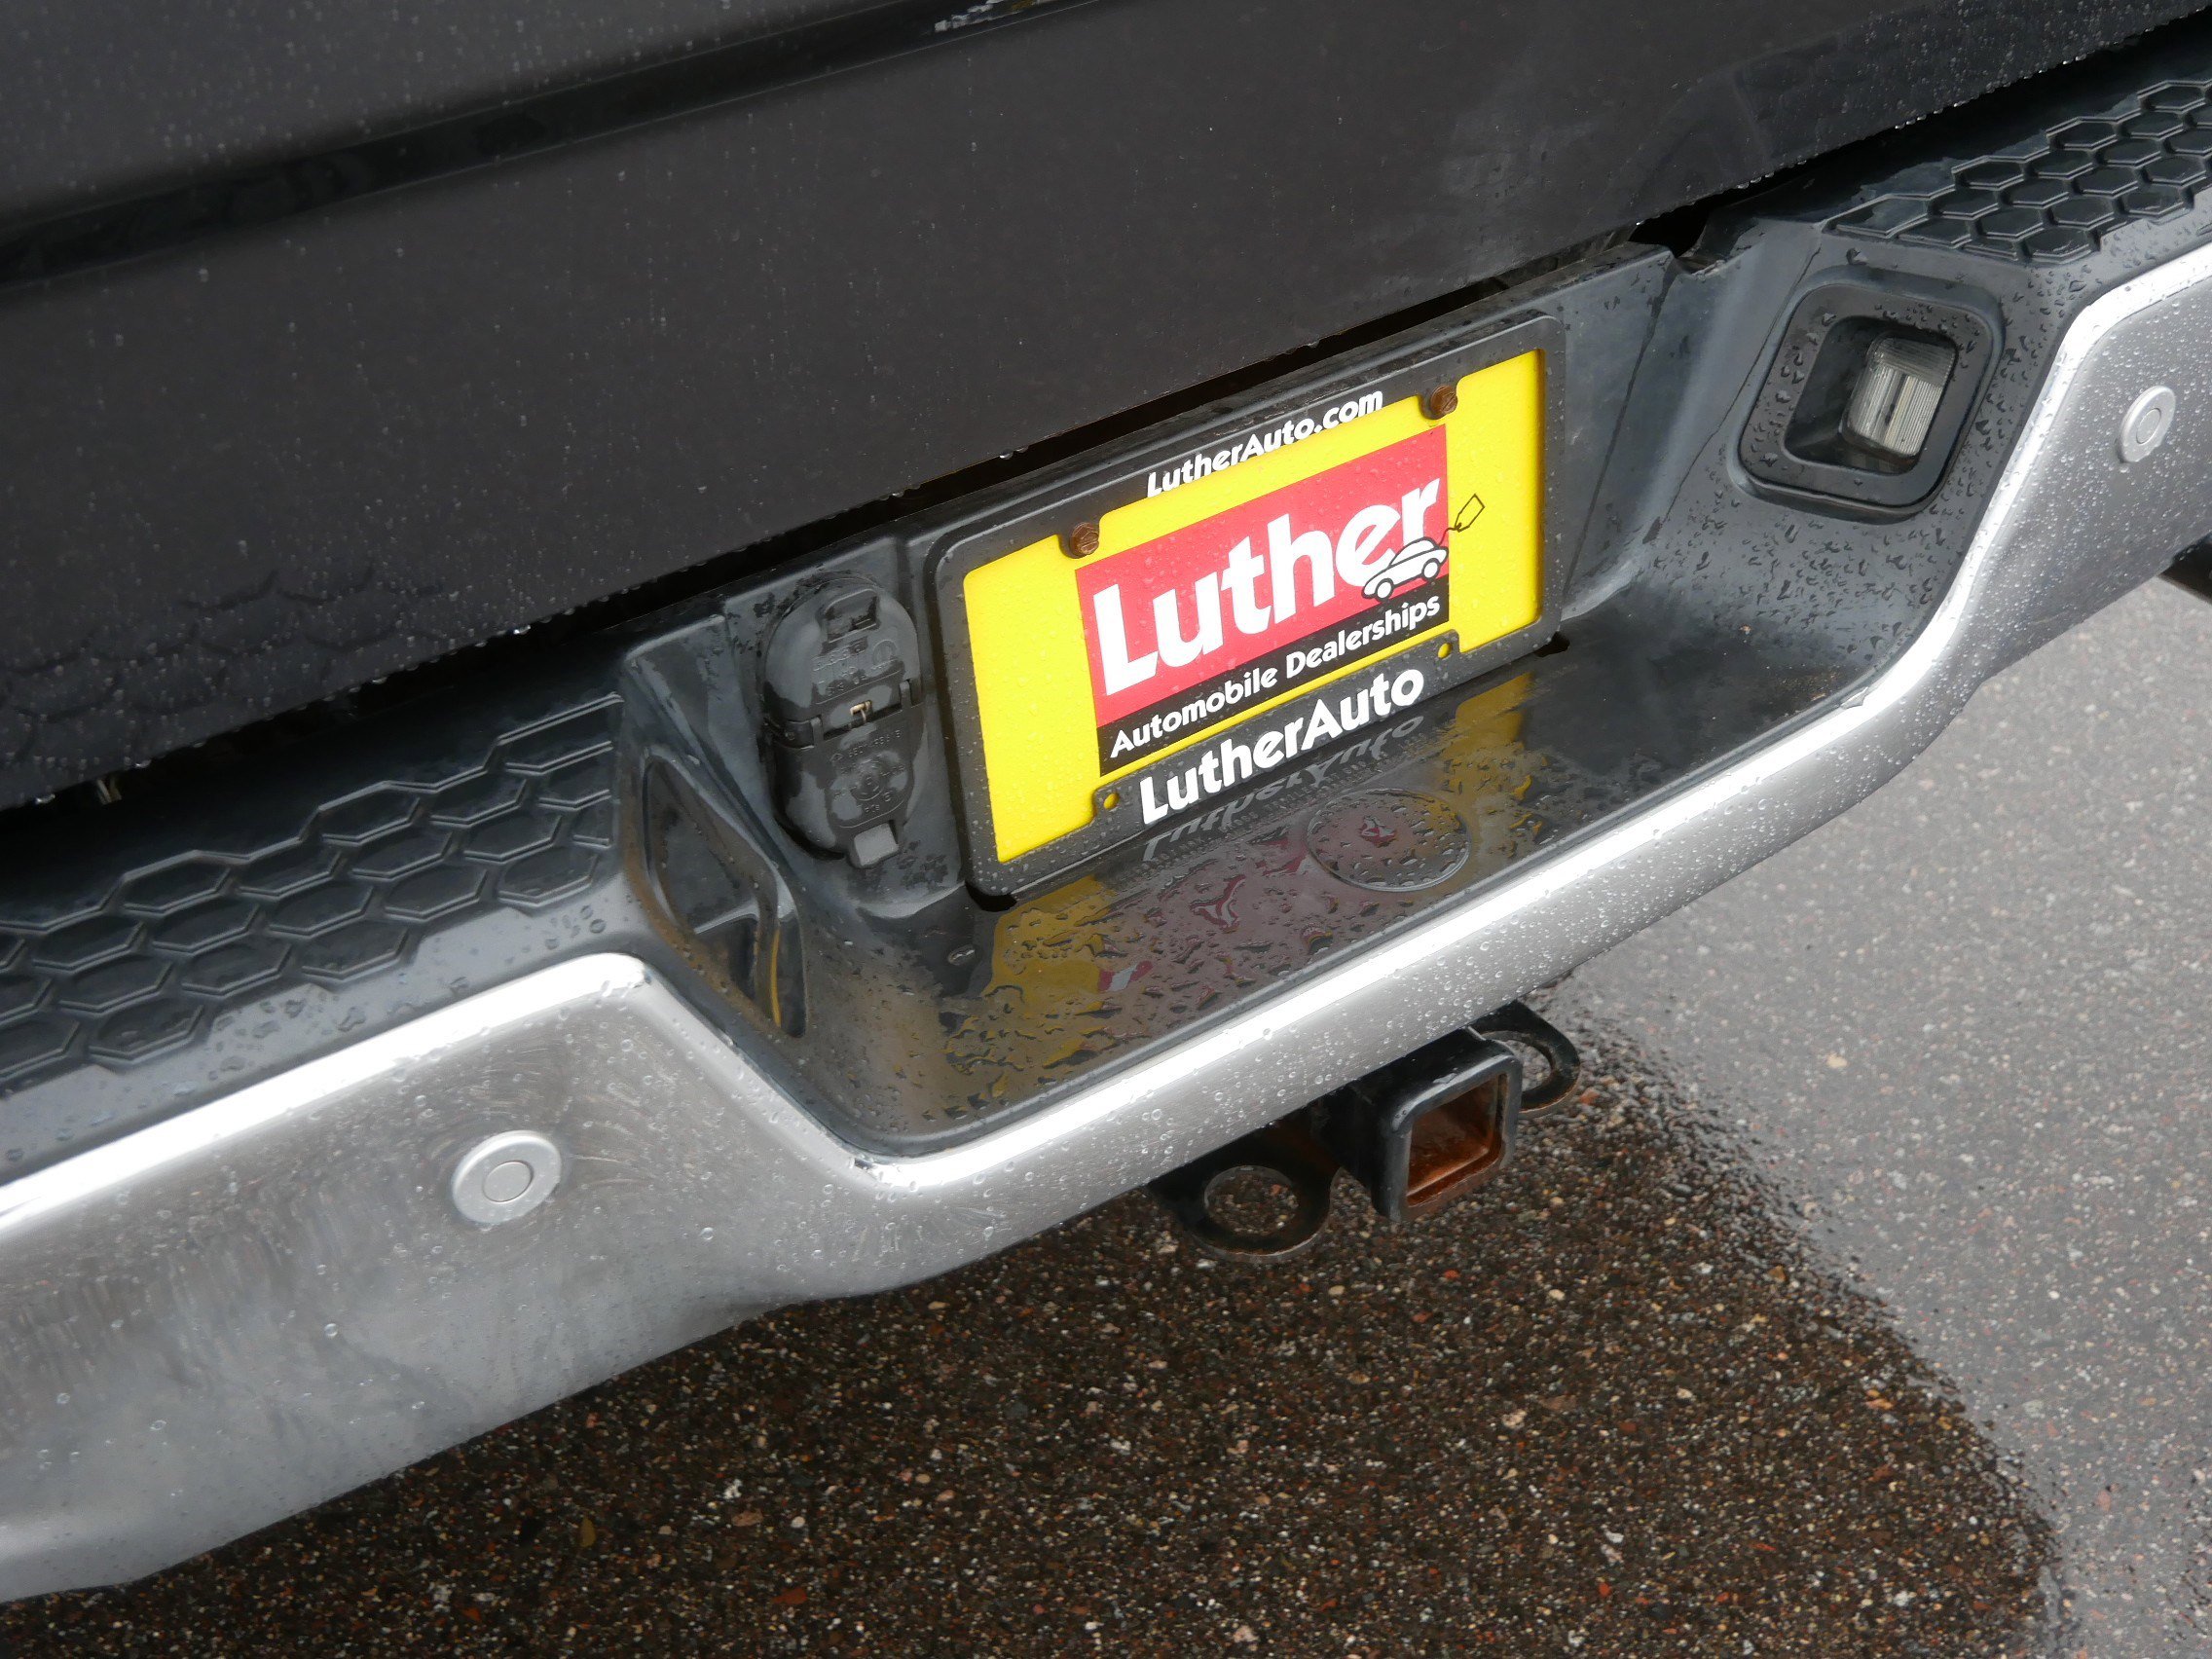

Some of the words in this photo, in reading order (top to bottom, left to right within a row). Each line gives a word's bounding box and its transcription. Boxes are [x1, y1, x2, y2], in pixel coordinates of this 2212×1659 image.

[1146, 391, 1382, 498] LutherAuto.com
[1093, 478, 1440, 696] Luther
[1110, 668, 1277, 758] Automobile
[1286, 596, 1441, 680] Dealerships
[1140, 669, 1424, 825] LutherAuto
